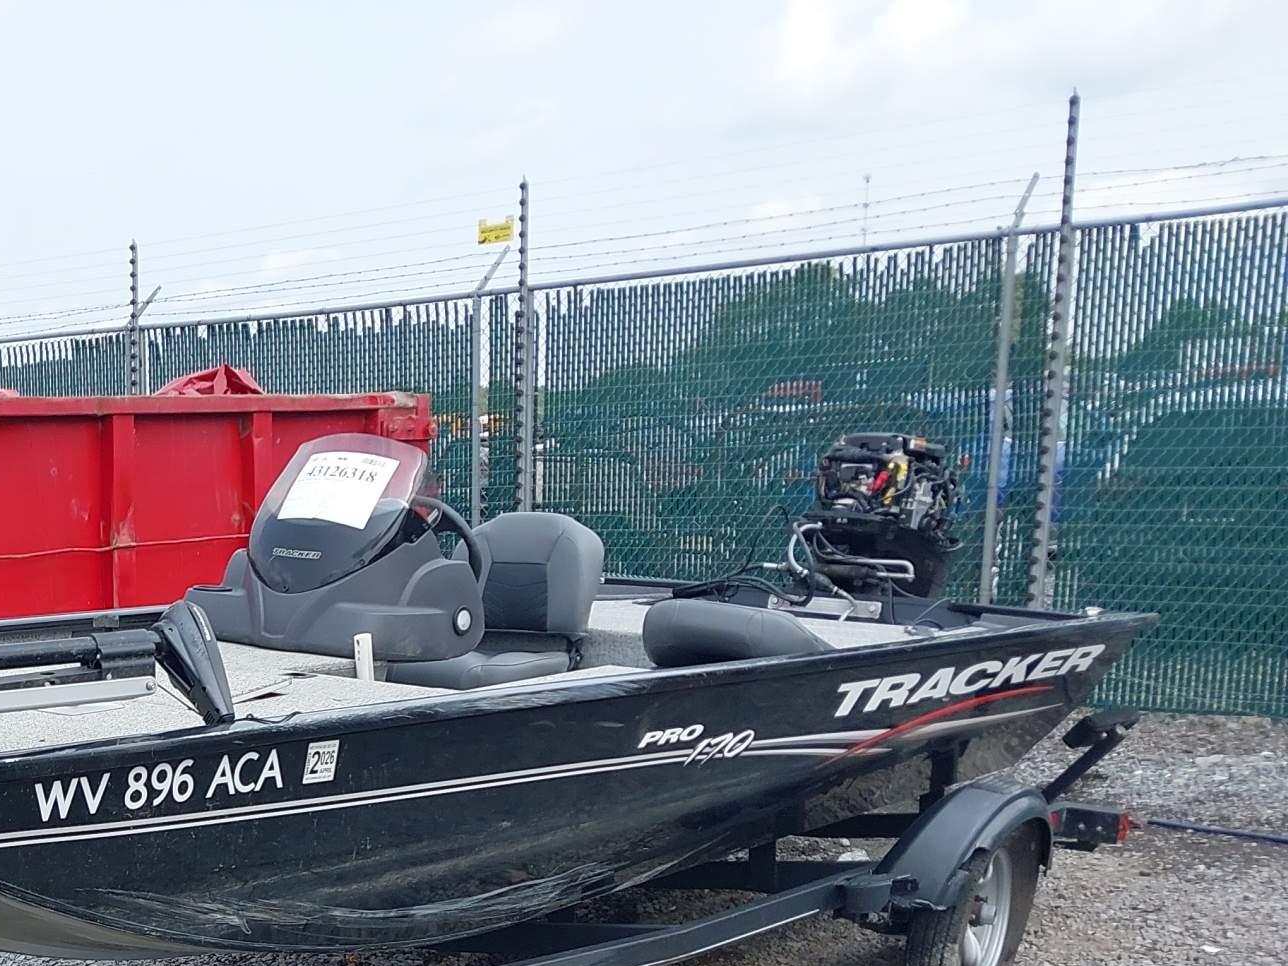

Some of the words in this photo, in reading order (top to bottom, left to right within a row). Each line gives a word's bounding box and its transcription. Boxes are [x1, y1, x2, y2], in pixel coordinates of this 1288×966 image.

[307, 465, 378, 483] 43126318
[834, 644, 1106, 718] TRACKER
[637, 724, 705, 749] PRO
[683, 730, 755, 767] 170
[309, 751, 335, 774] 2026
[35, 773, 110, 822] WV
[124, 759, 194, 811] 896
[205, 749, 283, 799] ACA
